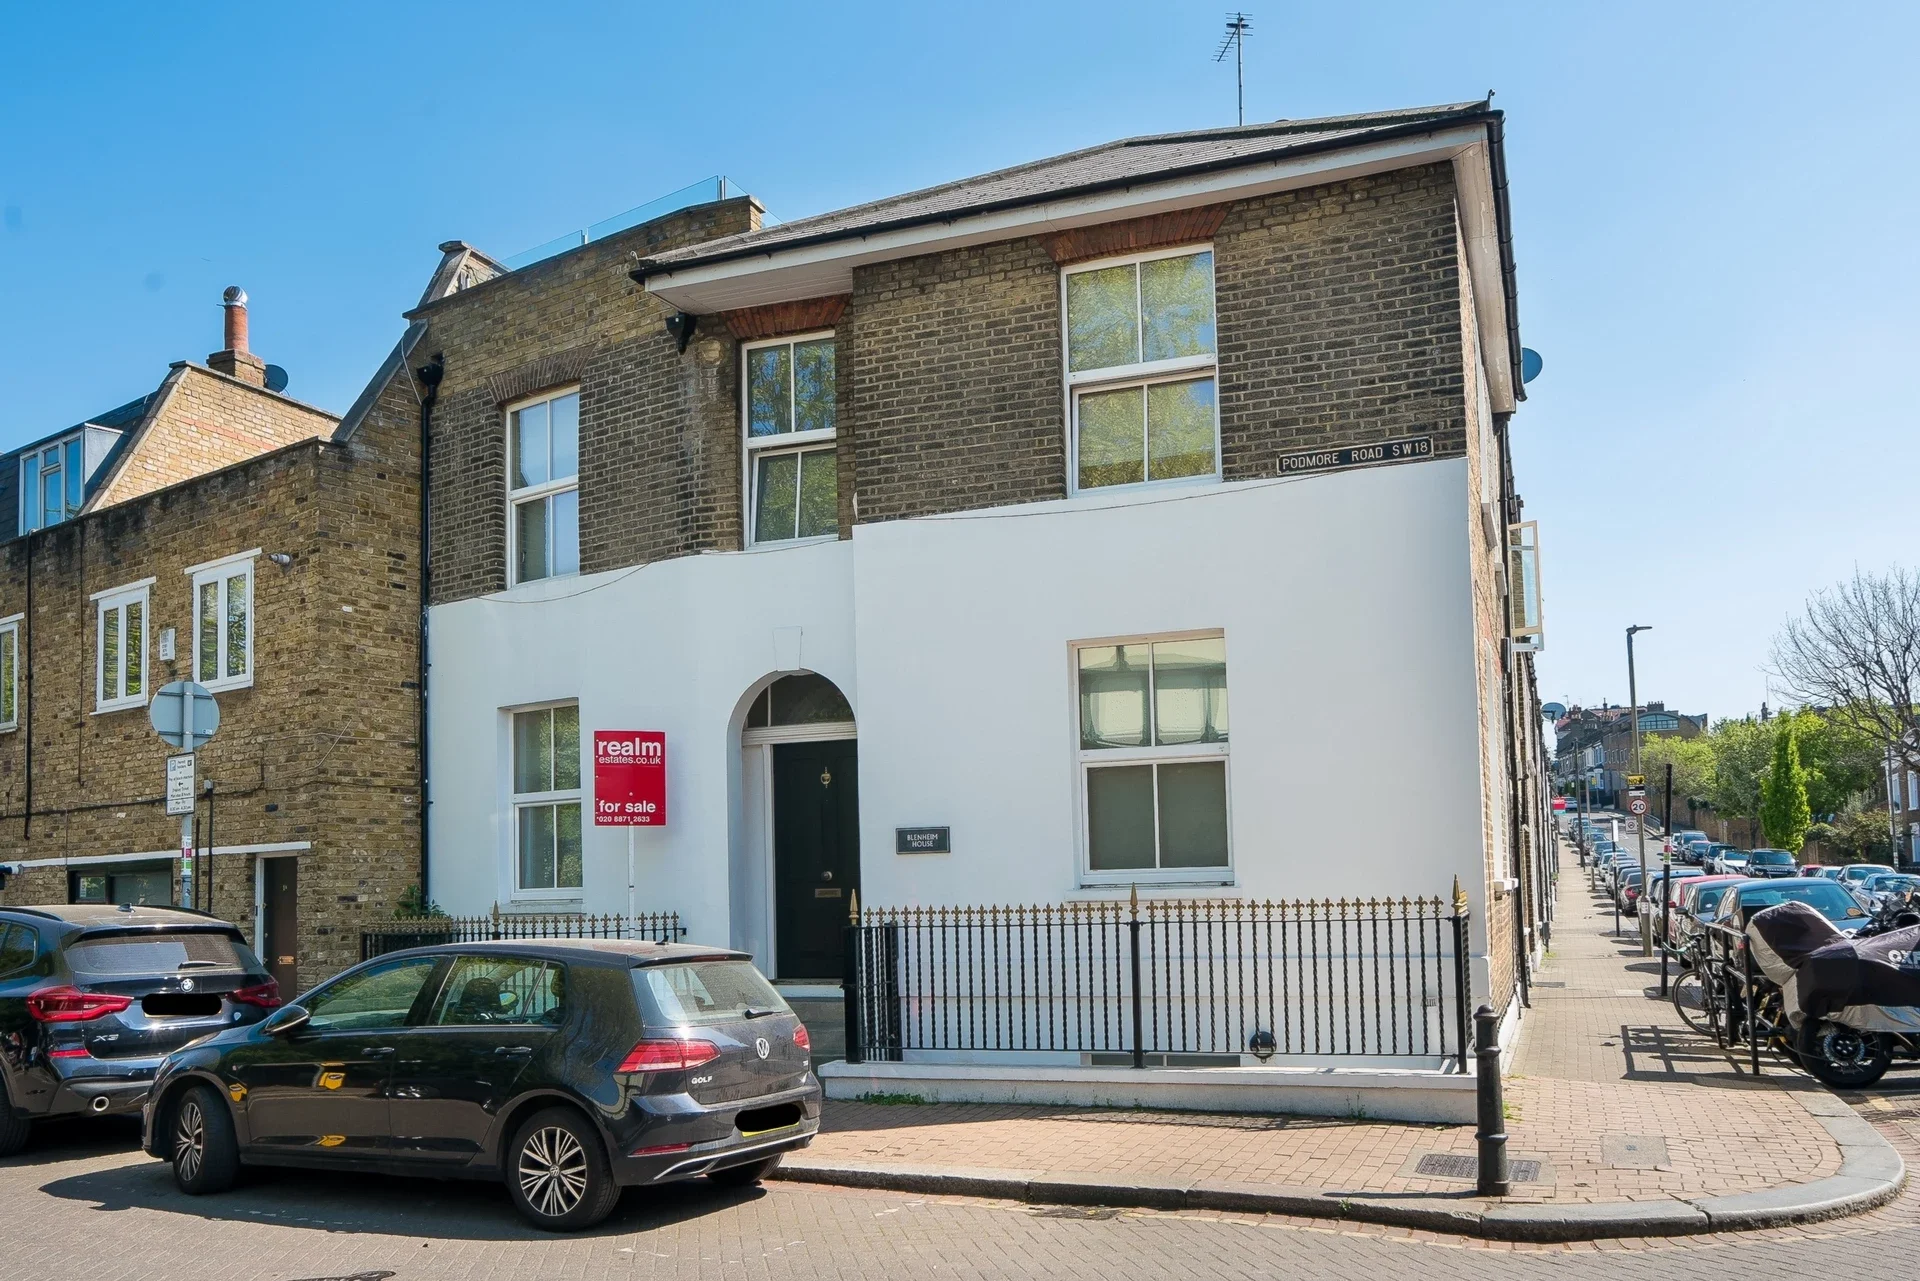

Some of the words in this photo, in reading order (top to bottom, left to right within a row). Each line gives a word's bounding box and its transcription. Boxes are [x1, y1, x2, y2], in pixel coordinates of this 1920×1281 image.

[1282, 452, 1340, 470] PODMORE
[1351, 447, 1384, 462] ROAD
[598, 737, 662, 756] realm
[599, 755, 661, 764] estates.co.uk
[599, 800, 621, 813] for
[625, 800, 656, 813] sale
[1632, 803, 1645, 811] 20
[92, 1033, 119, 1042] X3
[691, 1075, 713, 1085] GOLF
